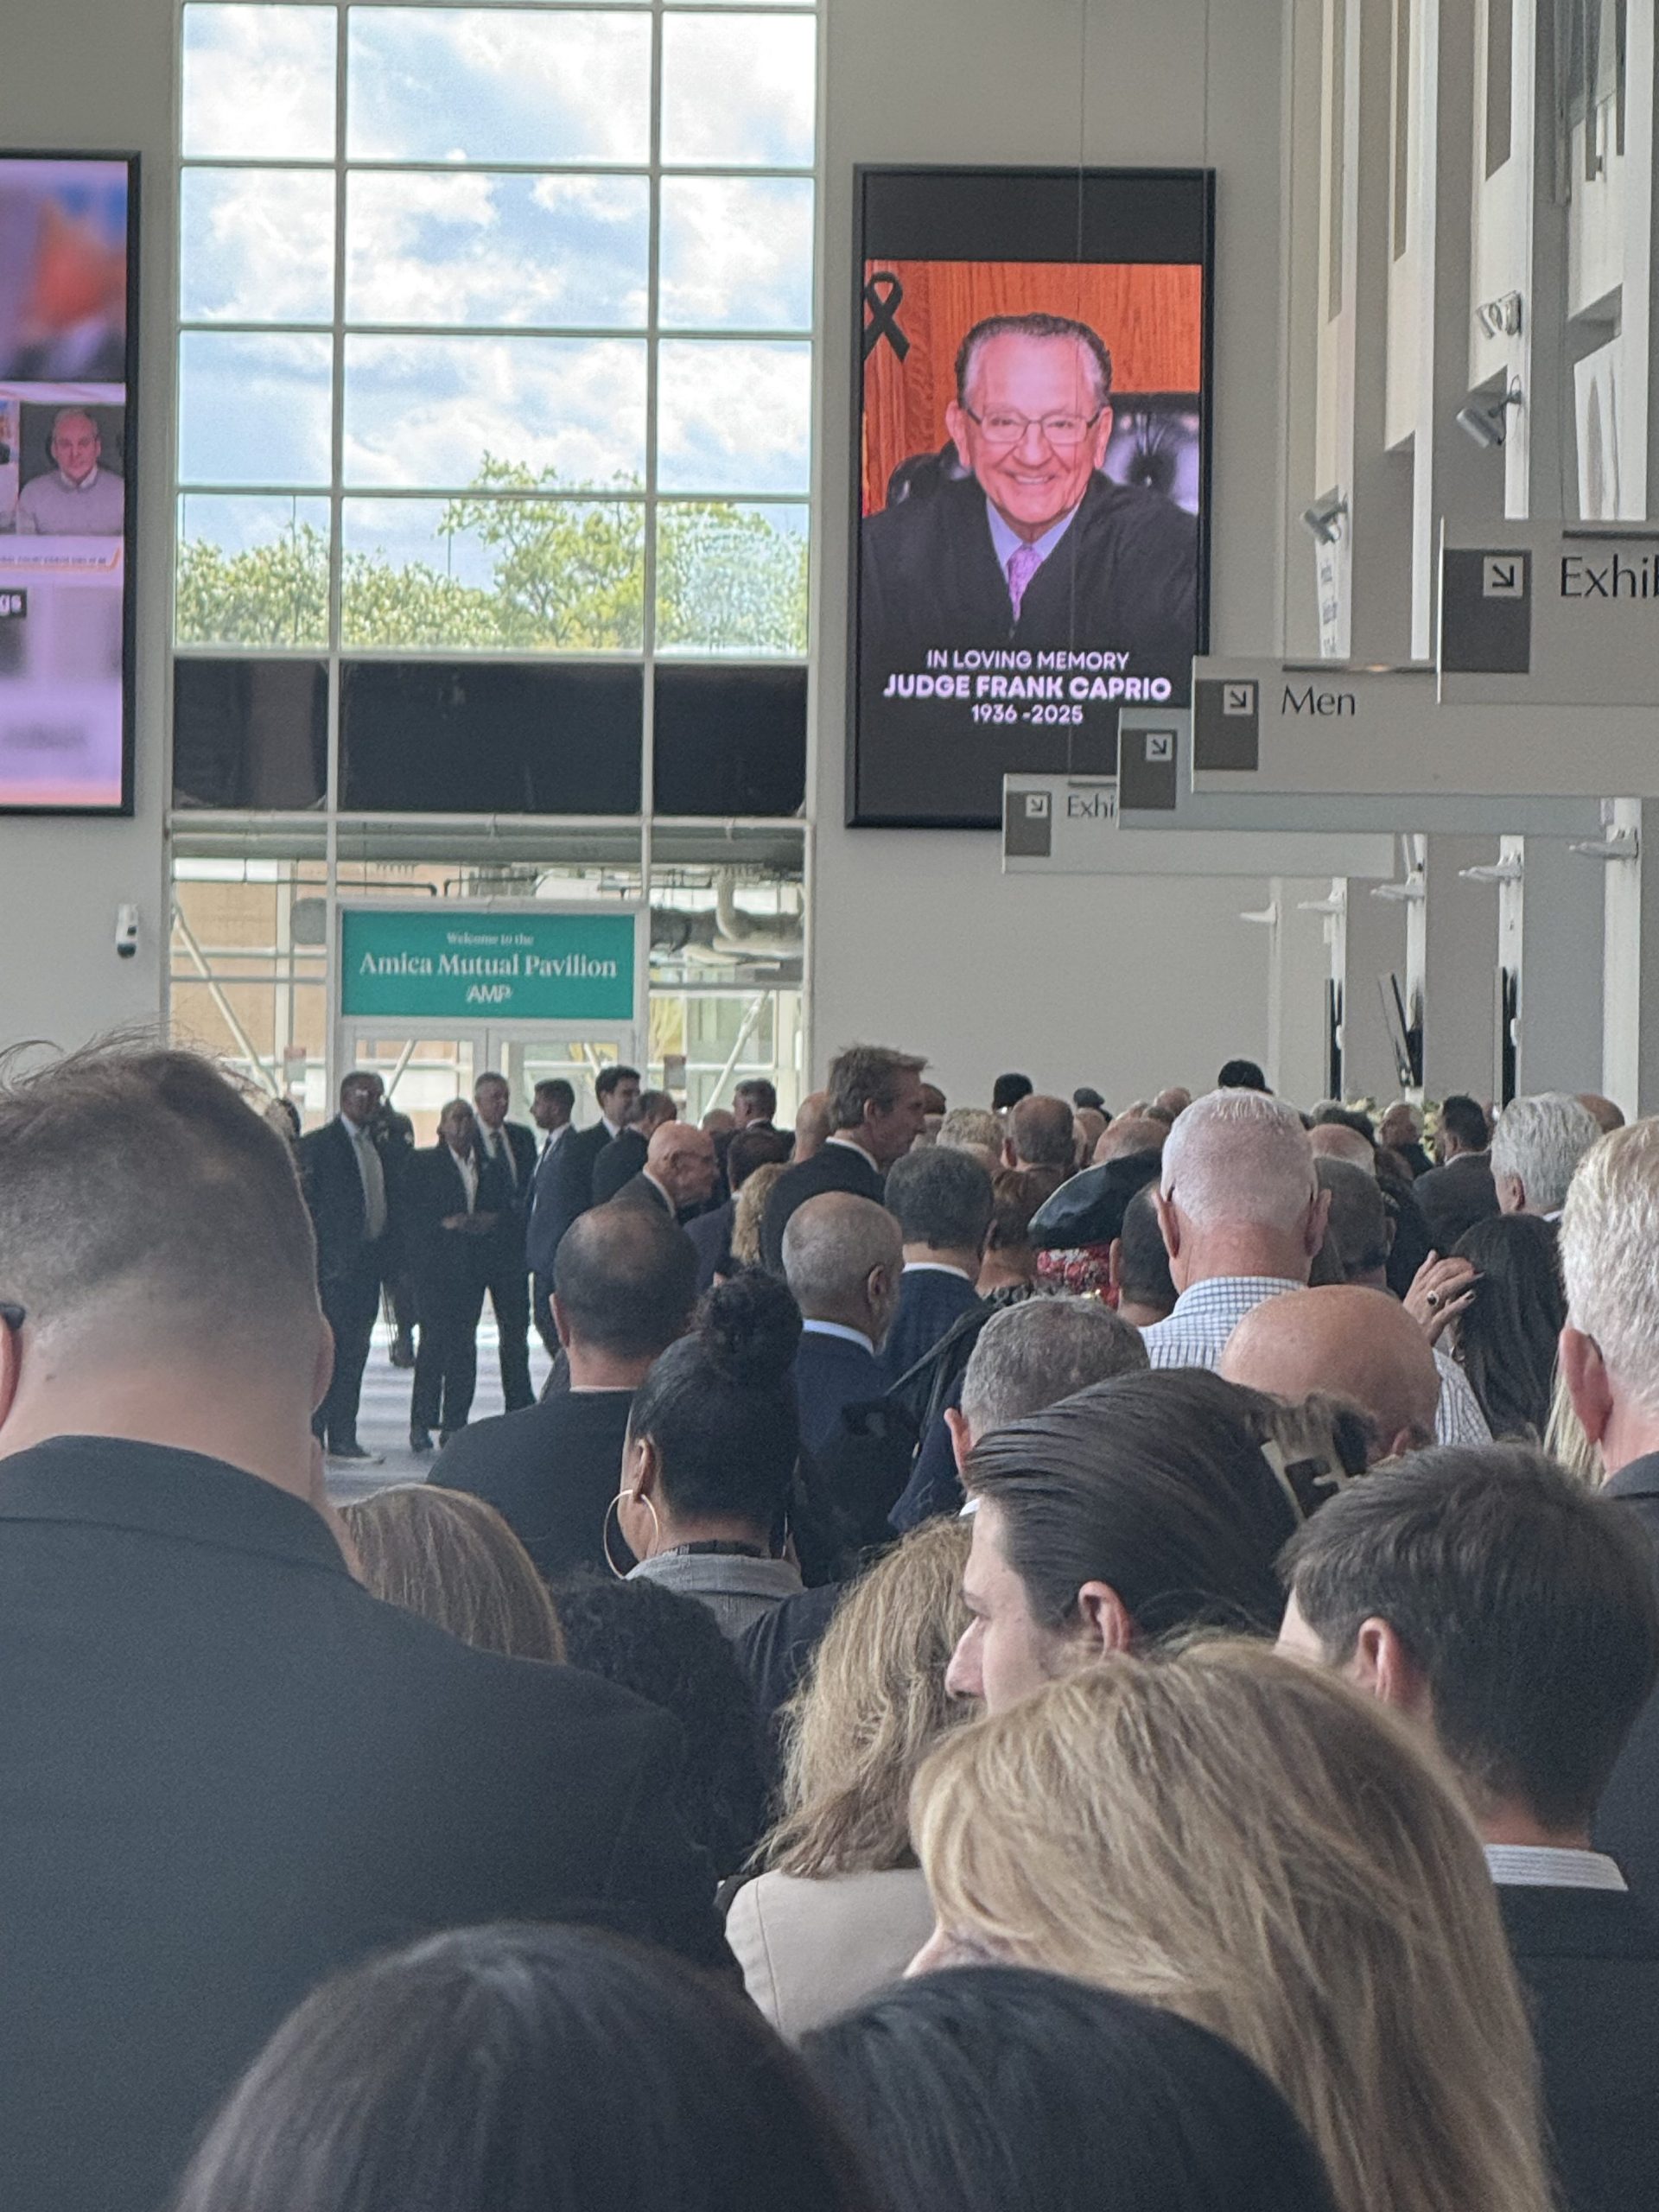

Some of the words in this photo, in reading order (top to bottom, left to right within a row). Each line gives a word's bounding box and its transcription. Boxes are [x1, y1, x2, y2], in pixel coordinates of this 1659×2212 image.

[926, 650, 948, 669] IN
[953, 650, 1033, 670] LOVING
[1037, 651, 1128, 671] MEMORY
[883, 674, 969, 698] JUDGE
[976, 676, 1064, 699] FRANK
[1069, 677, 1172, 701] CAPRIO
[1281, 684, 1355, 715] Men
[971, 703, 1017, 723] 1936
[1067, 793, 1117, 818] Exhi
[447, 931, 499, 945] Welcome
[500, 933, 512, 945] to
[515, 933, 534, 946] the
[359, 951, 432, 975] Amica
[438, 953, 518, 976] Mutual
[524, 953, 618, 978] Pavilion
[467, 984, 512, 1003] AMP
